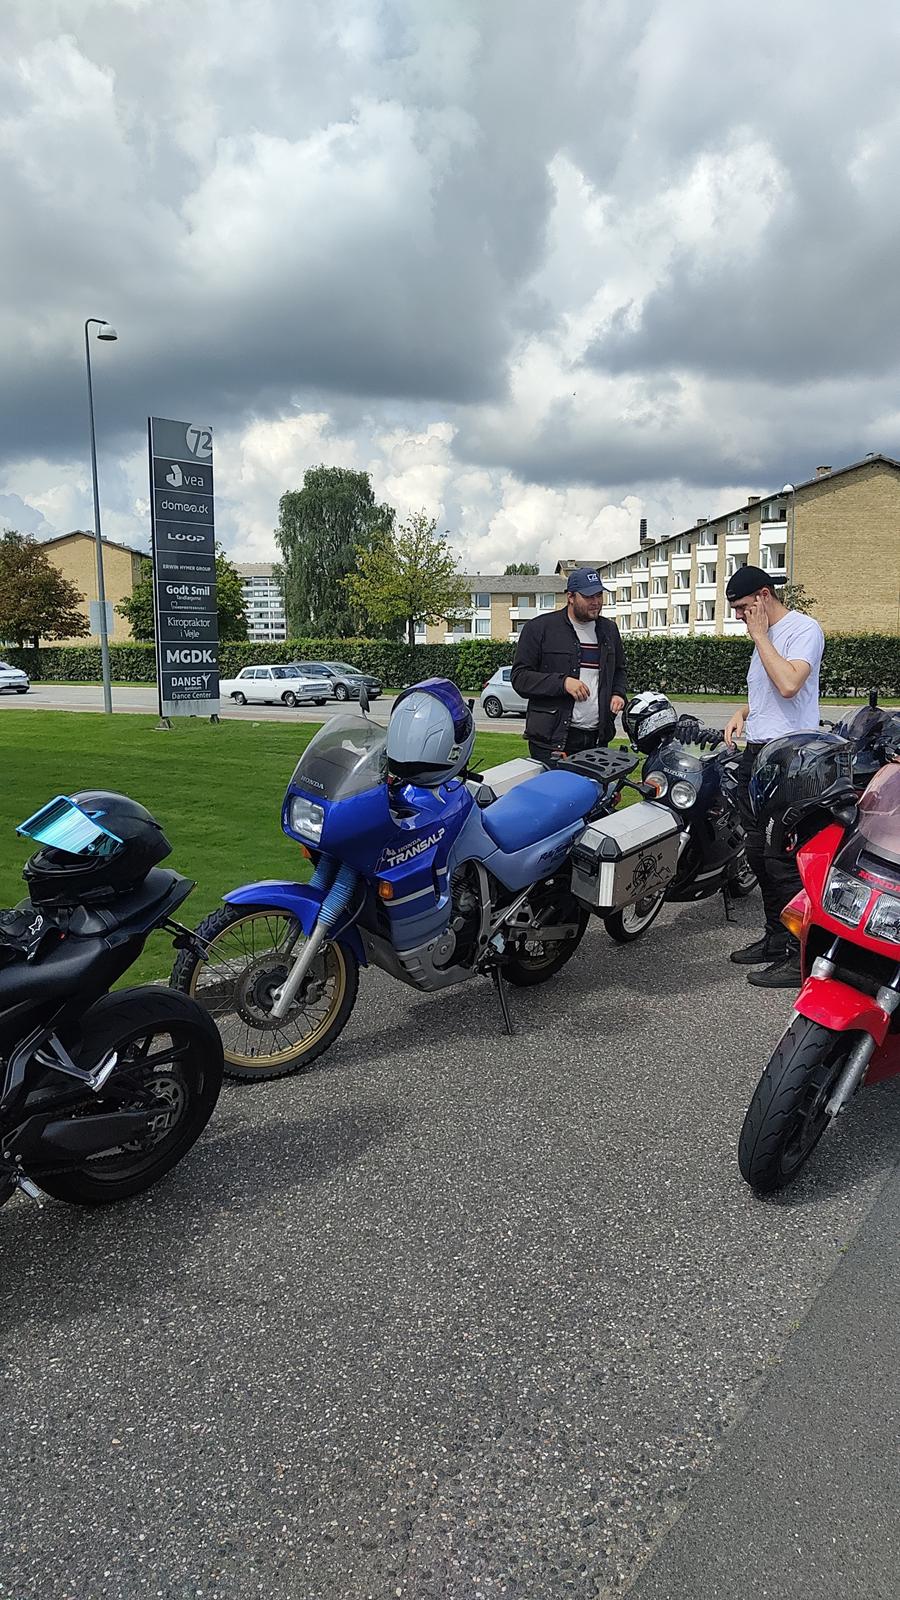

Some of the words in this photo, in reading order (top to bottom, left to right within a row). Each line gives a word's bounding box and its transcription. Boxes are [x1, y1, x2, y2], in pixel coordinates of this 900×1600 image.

[190, 429, 212, 455] 72
[167, 532, 205, 542] LOOP
[166, 585, 189, 595] Godt
[191, 586, 210, 596] Smil
[167, 616, 211, 629] Kiropraktor
[184, 630, 200, 640] Vejle
[172, 691, 191, 700] Dance
[663, 767, 687, 779] SUZUKI
[300, 775, 324, 790] HONDA
[387, 827, 445, 867] TRANSALP
[397, 838, 421, 854] HONDA
